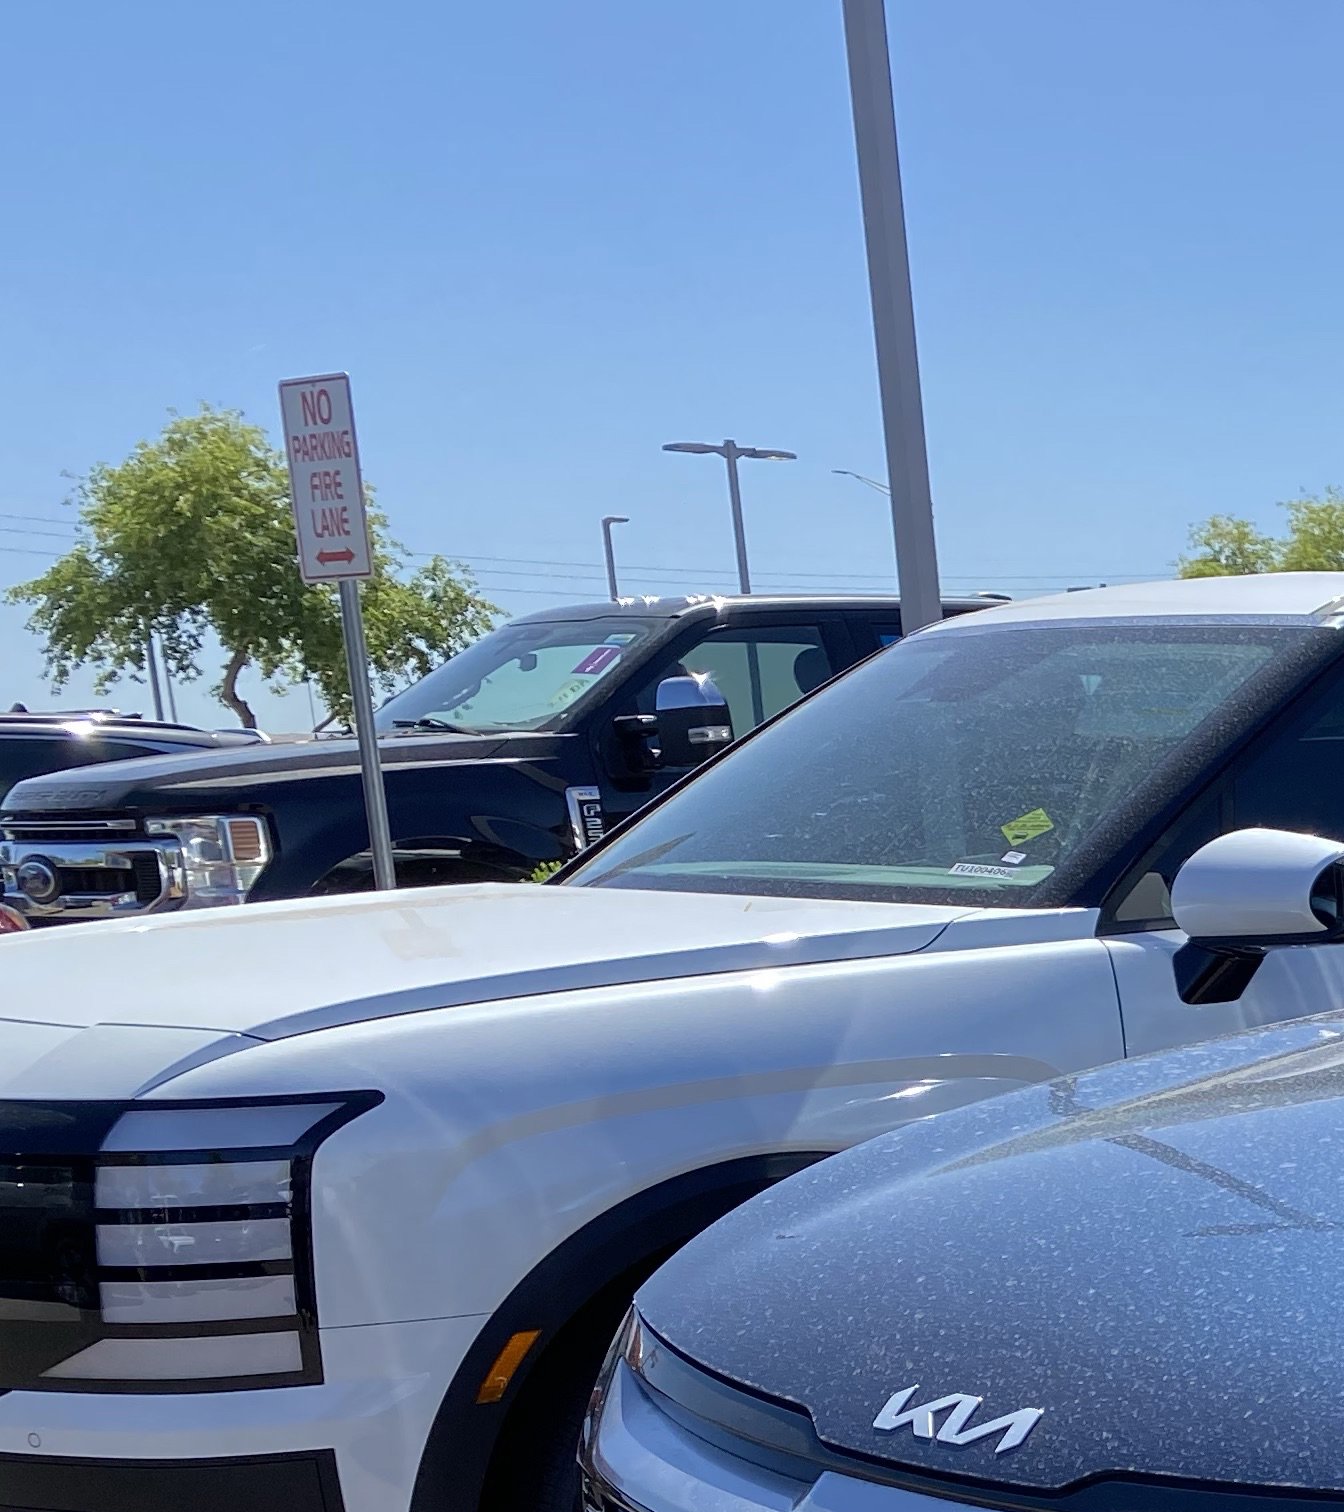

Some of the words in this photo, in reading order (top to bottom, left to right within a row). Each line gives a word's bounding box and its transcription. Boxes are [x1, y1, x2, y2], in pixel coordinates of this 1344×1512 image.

[301, 388, 332, 427] NO
[292, 430, 353, 463] PARKING
[309, 469, 344, 502] FIRE
[310, 505, 351, 539] LANE
[873, 1384, 1045, 1453] KIA
